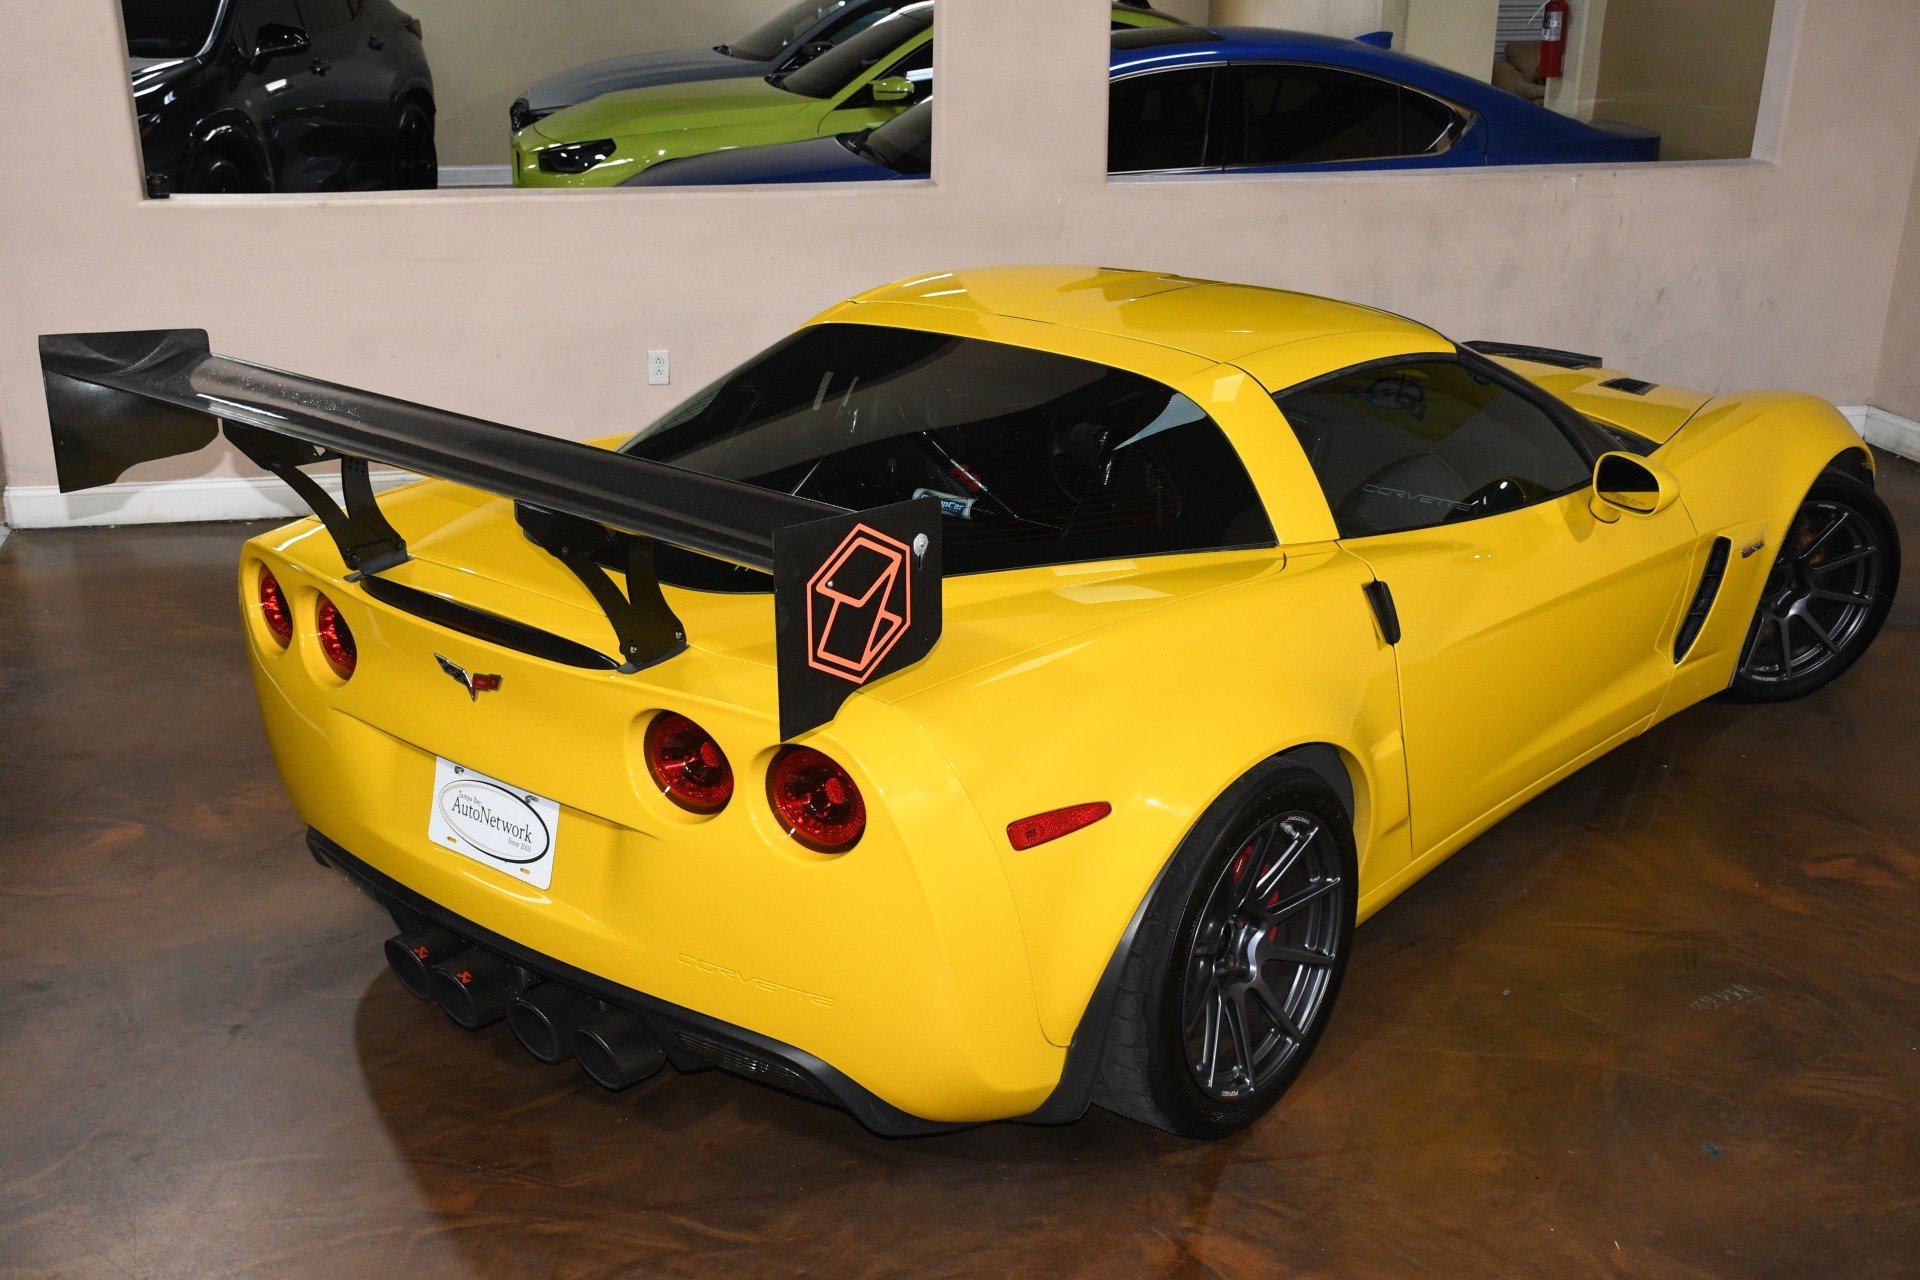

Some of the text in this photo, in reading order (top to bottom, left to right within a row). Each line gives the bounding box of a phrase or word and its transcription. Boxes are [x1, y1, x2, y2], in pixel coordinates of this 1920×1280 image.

[1363, 484, 1472, 512] CORVETTE
[474, 796, 482, 807] Bay
[451, 797, 533, 844] AutoNetwork
[508, 837, 532, 853] Since 2005
[676, 952, 836, 1008] CORVETTE
